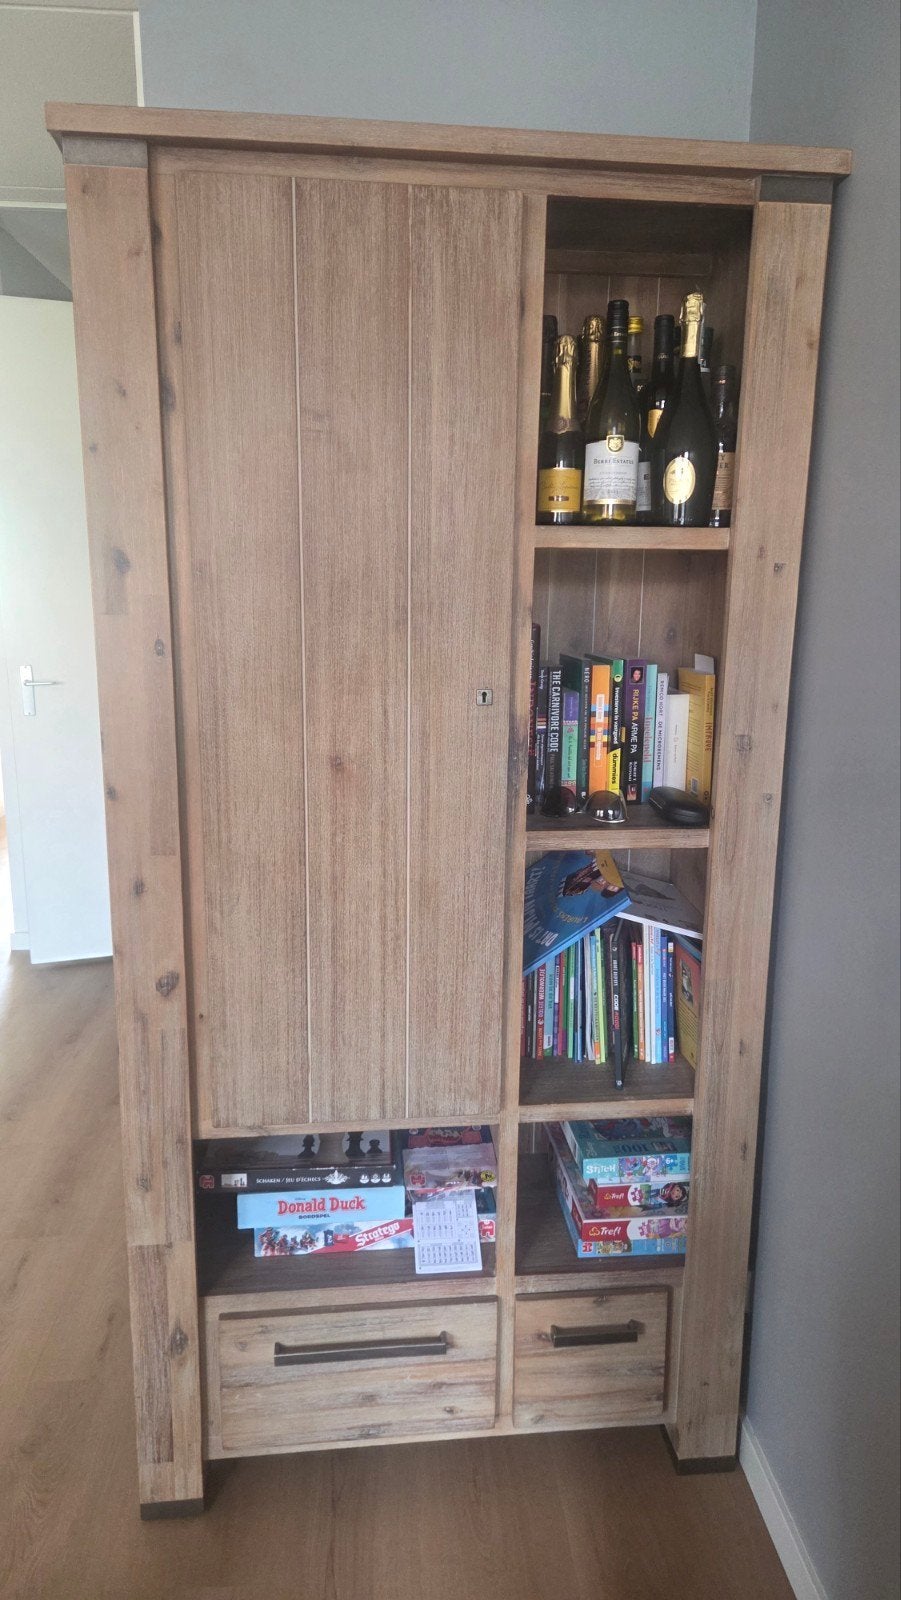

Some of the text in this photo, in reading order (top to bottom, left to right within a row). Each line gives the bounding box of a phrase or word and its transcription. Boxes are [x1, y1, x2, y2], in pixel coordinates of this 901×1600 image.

[549, 670, 562, 753] THE CARNIVORE CODE
[630, 689, 640, 753] RIJKE PA ARME PA
[612, 721, 620, 744] vastgoed
[611, 753, 619, 784] dummies
[277, 1195, 366, 1215] Donald Duck
[611, 1192, 625, 1200] Trefl
[355, 1220, 400, 1248] Stratego
[600, 1226, 622, 1236] Trefl
